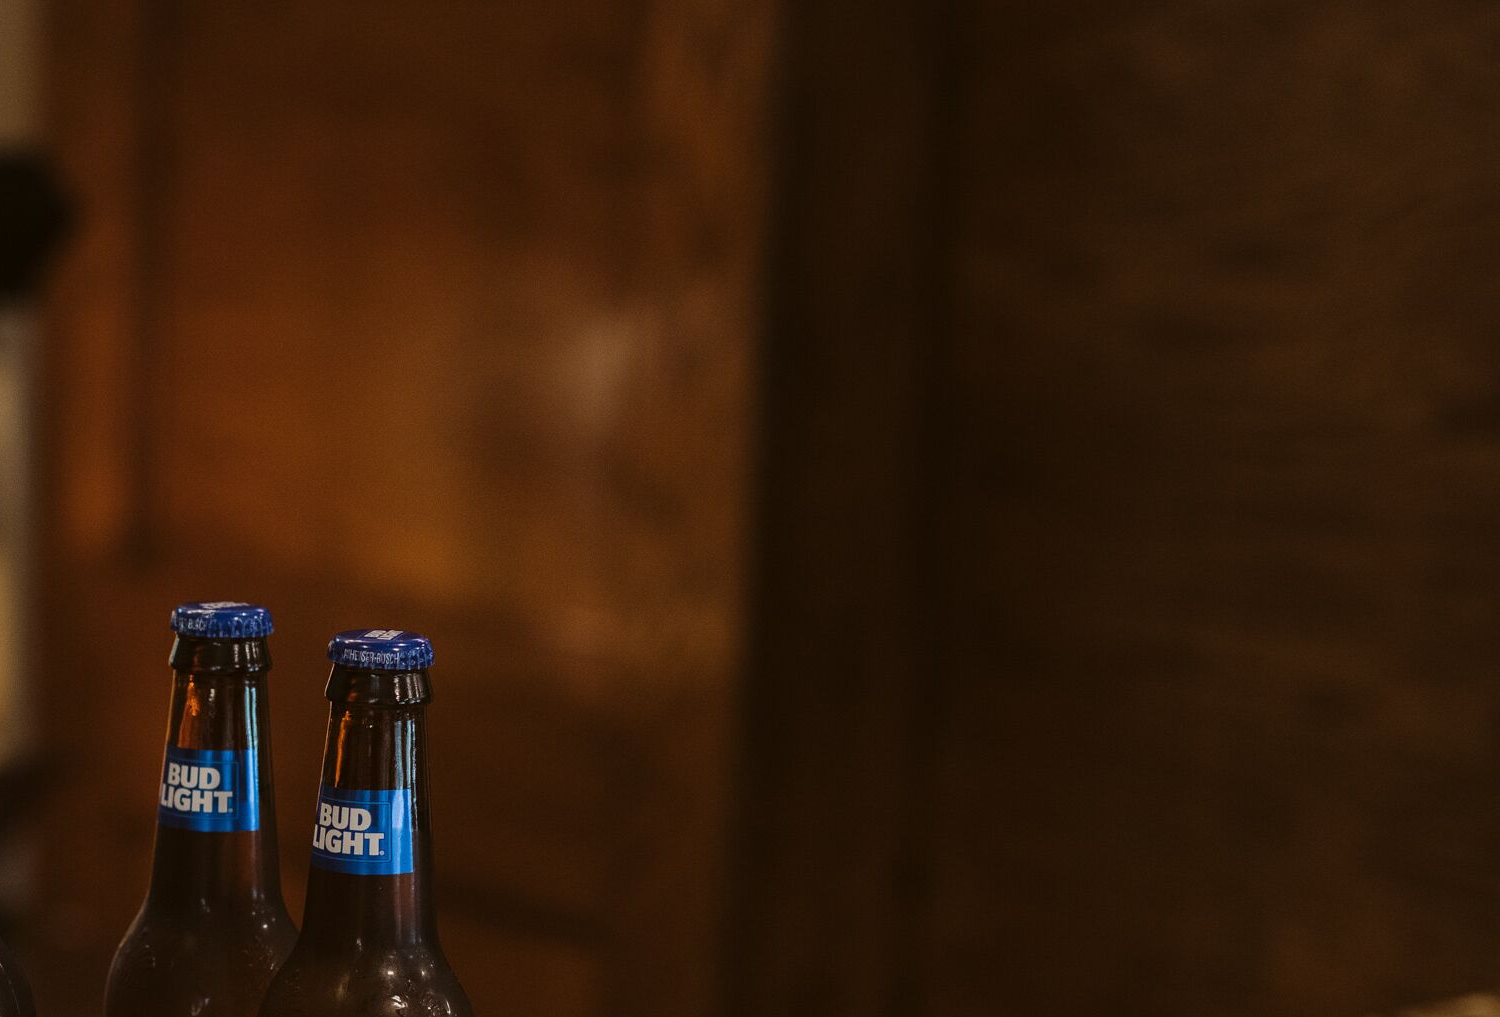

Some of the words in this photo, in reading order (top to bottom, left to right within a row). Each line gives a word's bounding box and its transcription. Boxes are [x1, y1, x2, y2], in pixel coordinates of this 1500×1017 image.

[168, 762, 220, 790] BUD
[161, 783, 233, 814] LIGHT
[319, 802, 372, 831] BUD
[312, 824, 385, 856] LIGHT
